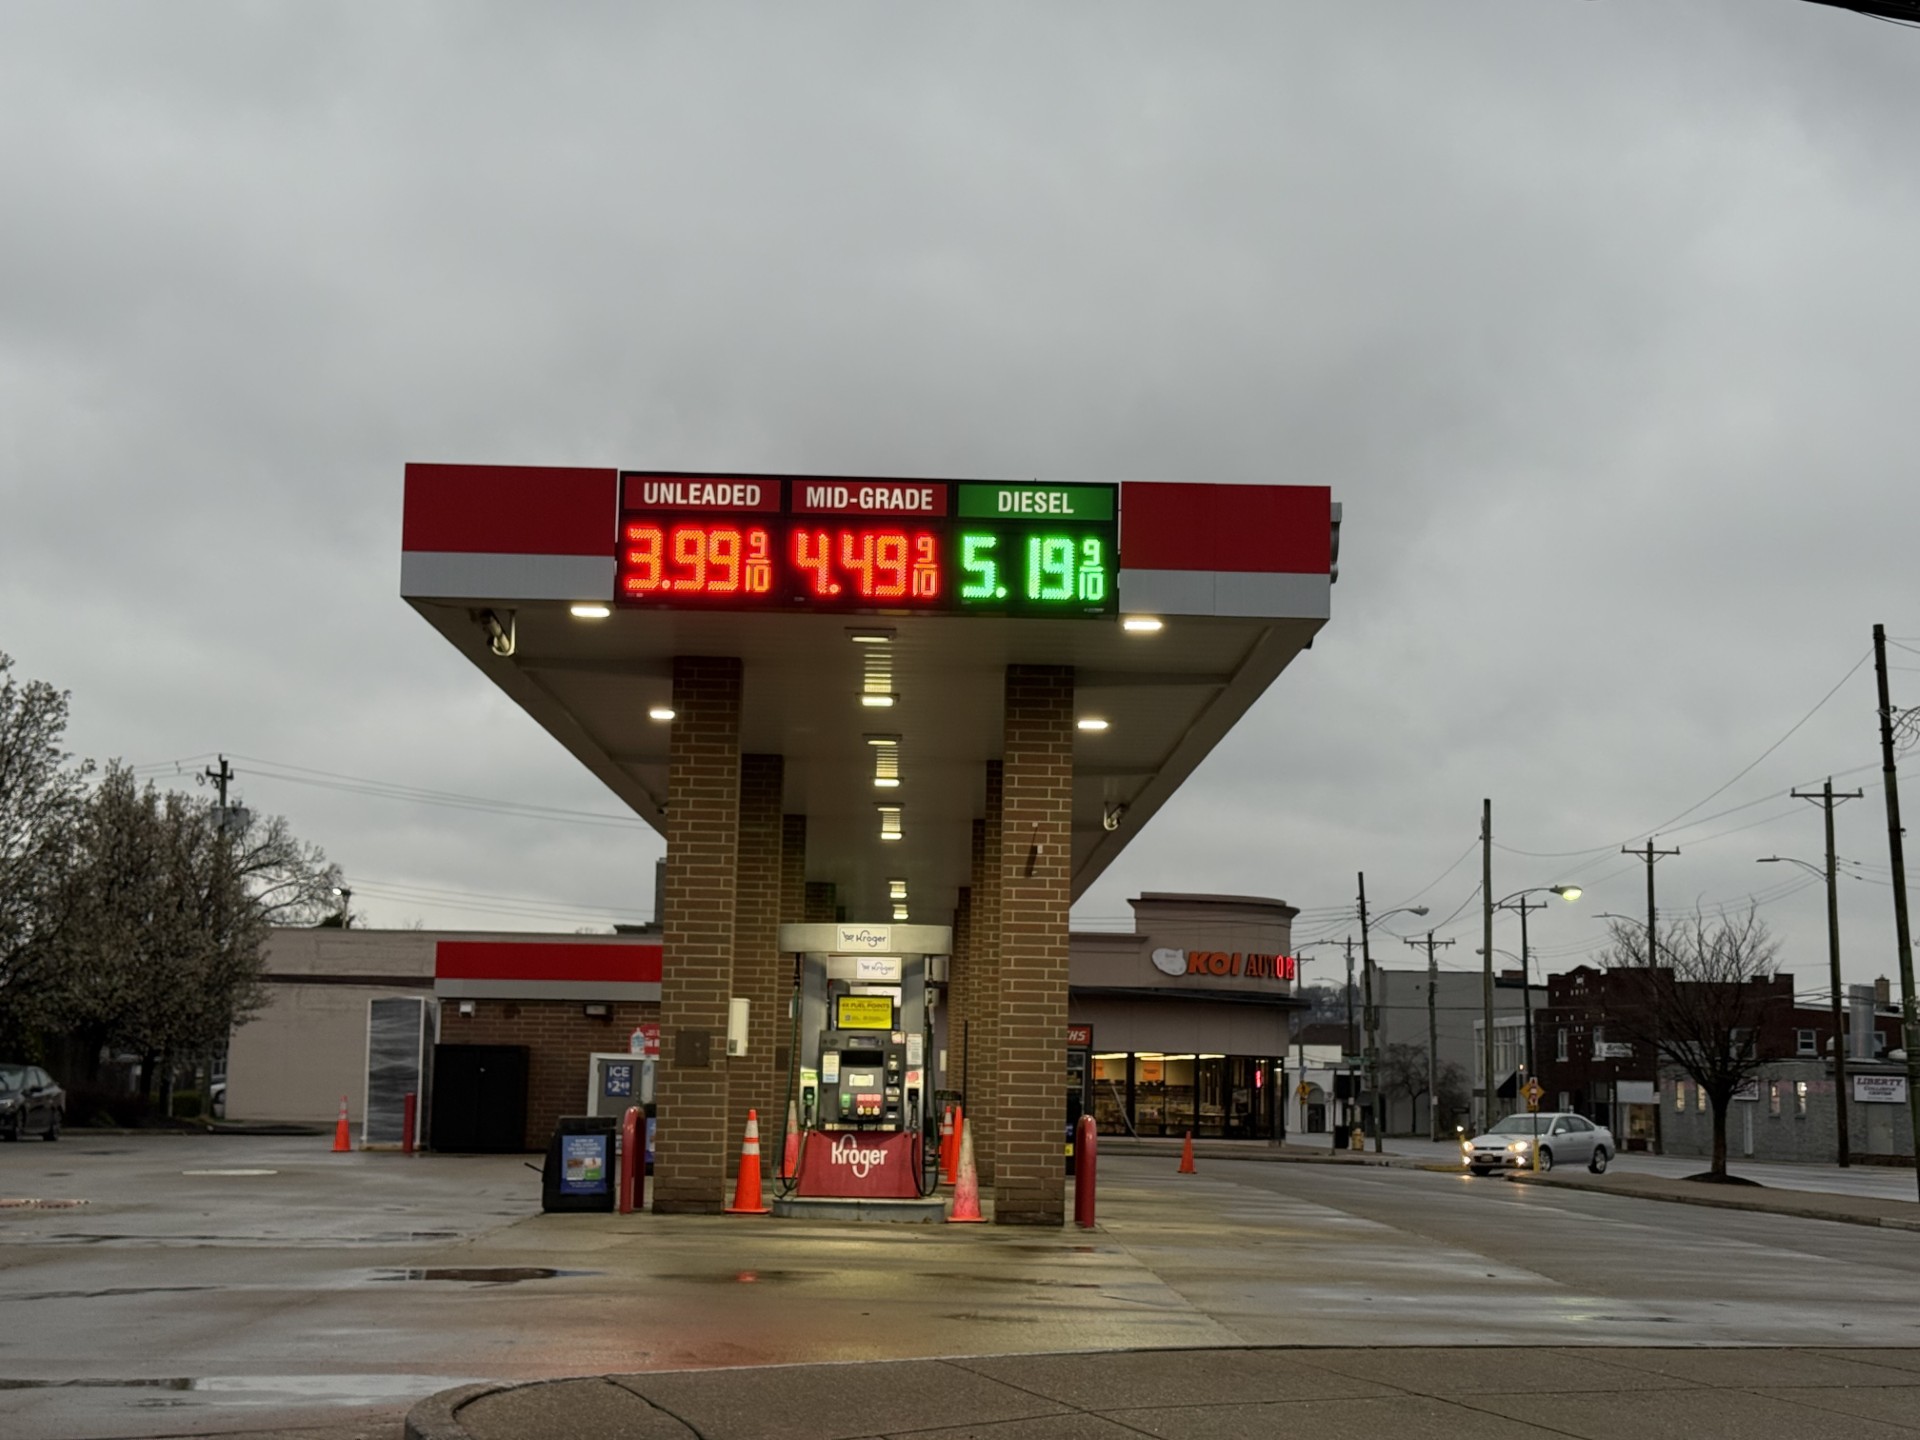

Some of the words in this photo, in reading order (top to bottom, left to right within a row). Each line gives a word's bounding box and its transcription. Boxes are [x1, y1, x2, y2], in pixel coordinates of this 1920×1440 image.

[643, 483, 762, 507] UNLEADED
[805, 486, 934, 511] MID-GRADE
[997, 490, 1075, 515] DIESEL
[627, 526, 741, 593] 3.99
[795, 532, 907, 597] 4.49
[856, 929, 887, 948] Kroger
[1187, 951, 1243, 977] KOI
[609, 1065, 630, 1078] ICE
[1856, 1077, 1904, 1087] LIBERTY
[831, 1133, 889, 1179] Kroger
